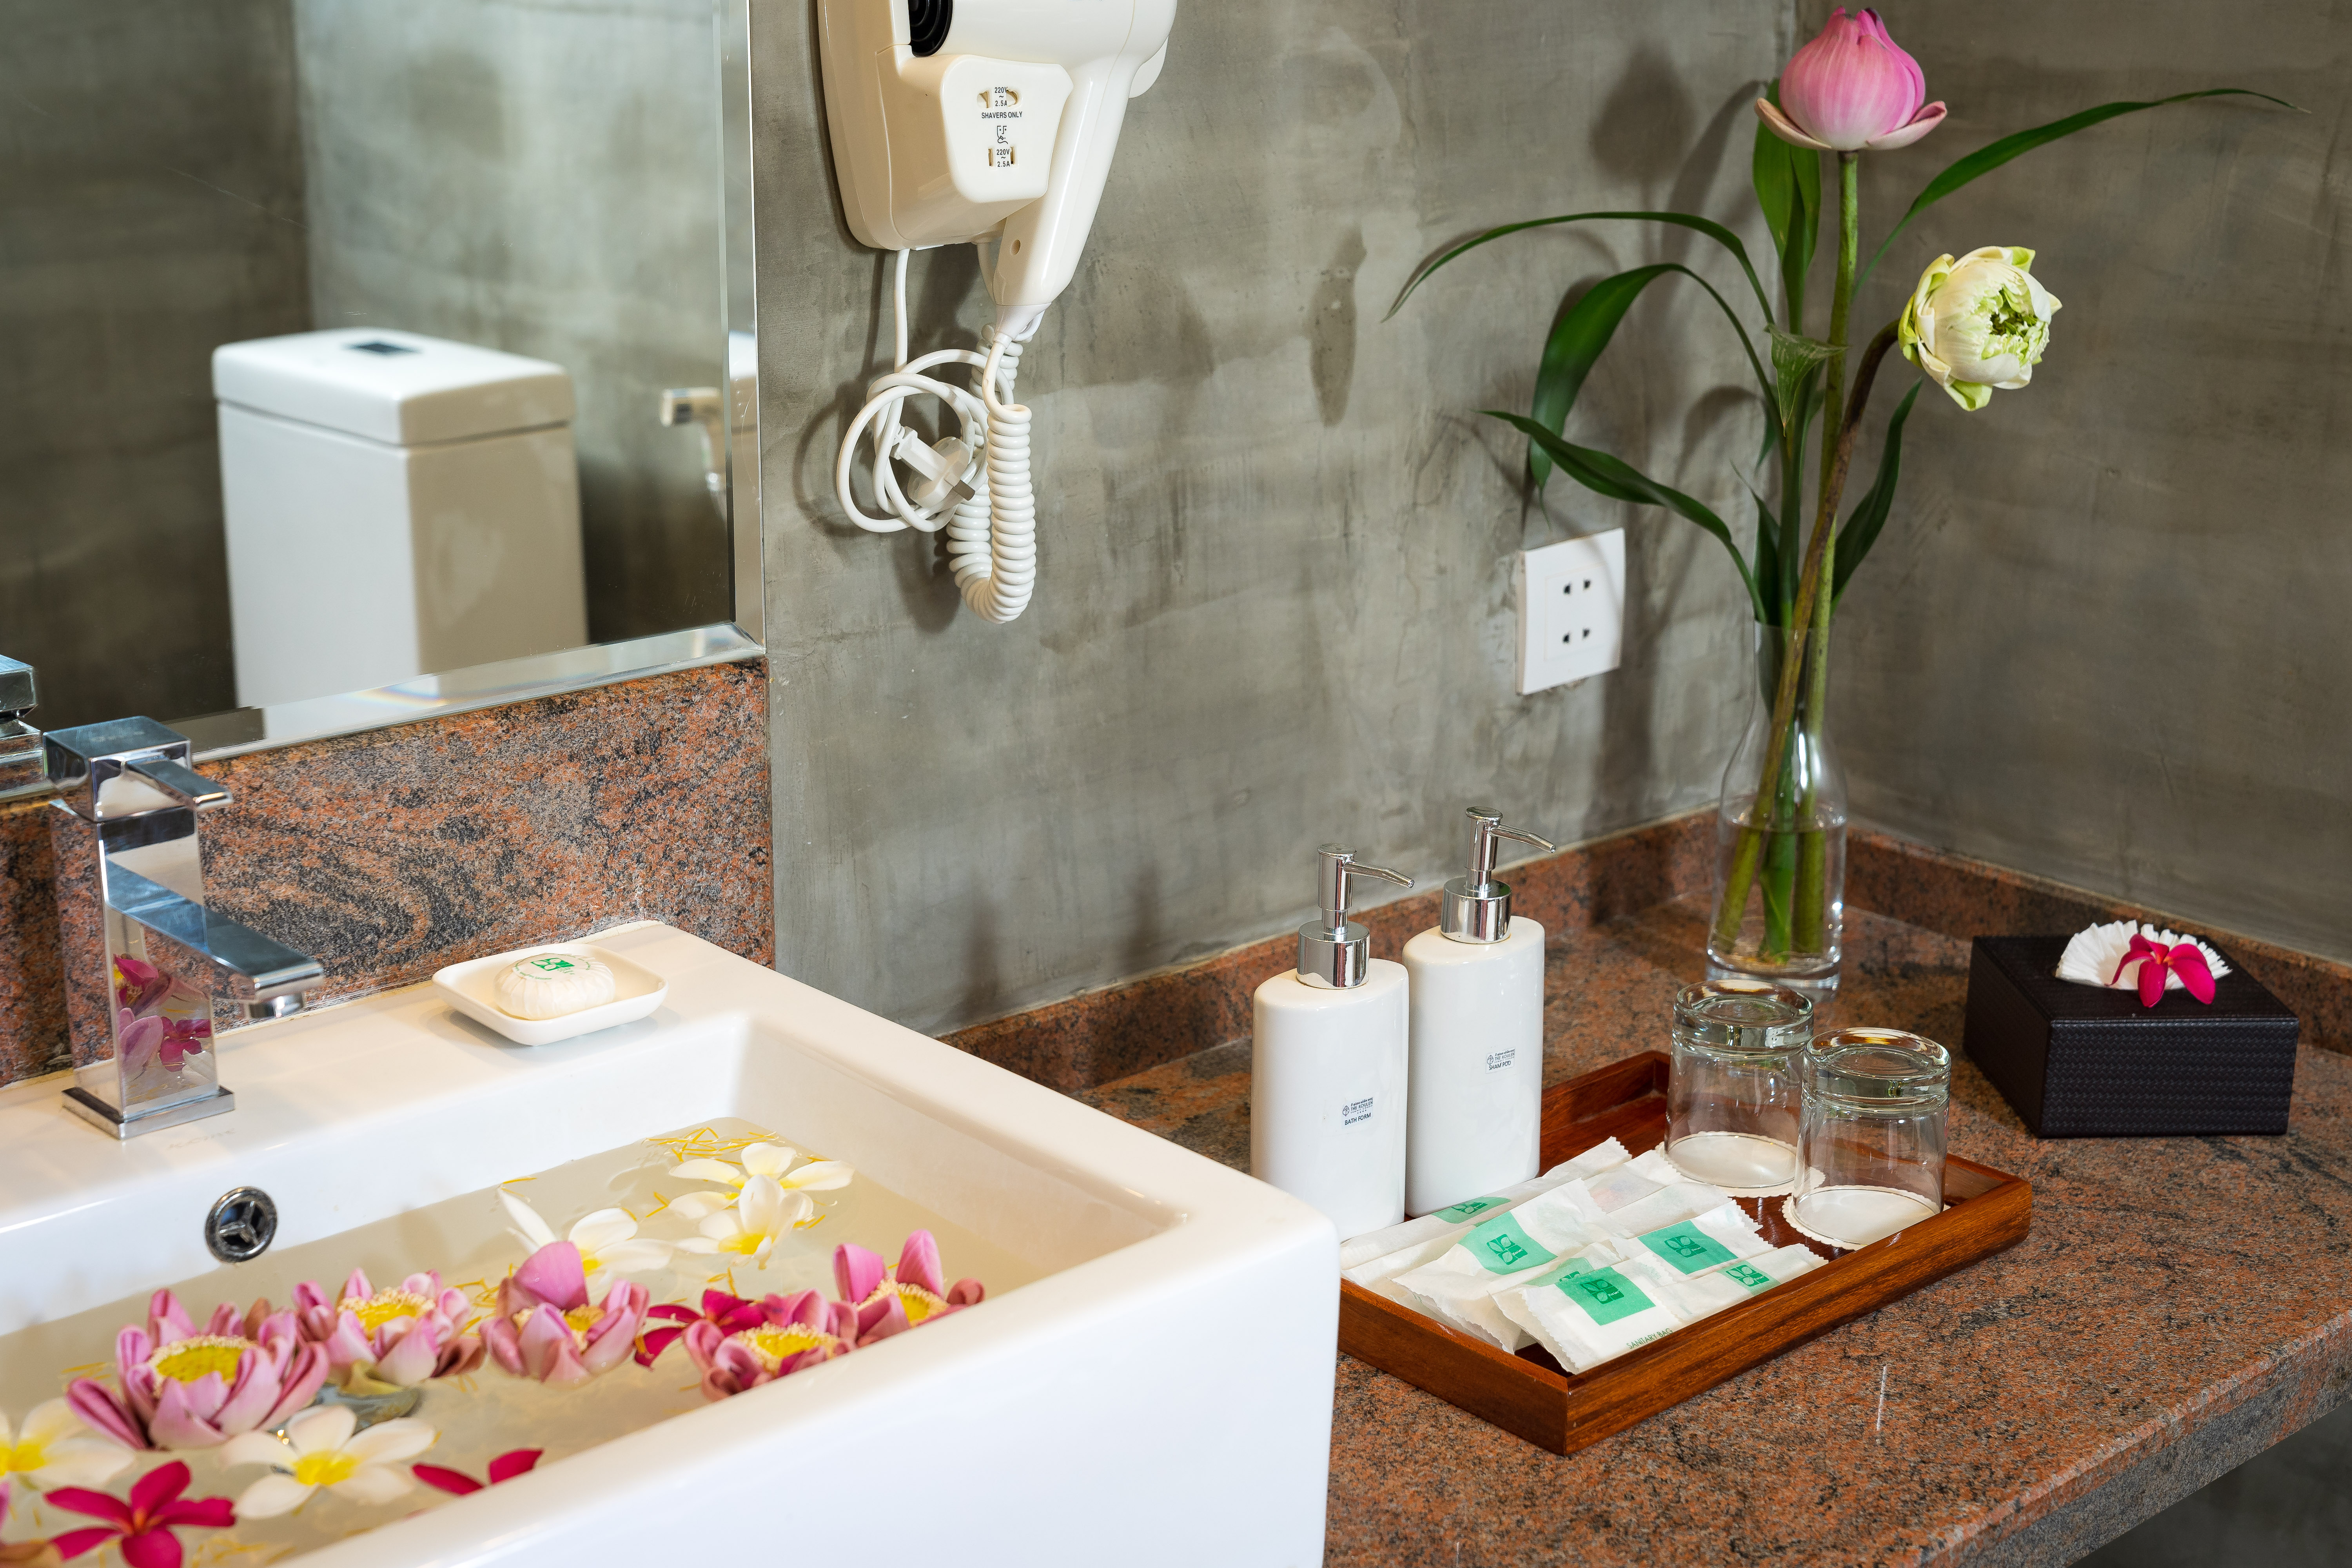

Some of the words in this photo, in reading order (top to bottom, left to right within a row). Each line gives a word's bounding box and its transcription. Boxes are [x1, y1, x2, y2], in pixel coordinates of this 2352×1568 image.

[1358, 1112, 1371, 1121] FORM
[1626, 1333, 1657, 1349] SANITARY
[1657, 1328, 1673, 1337] BAG
